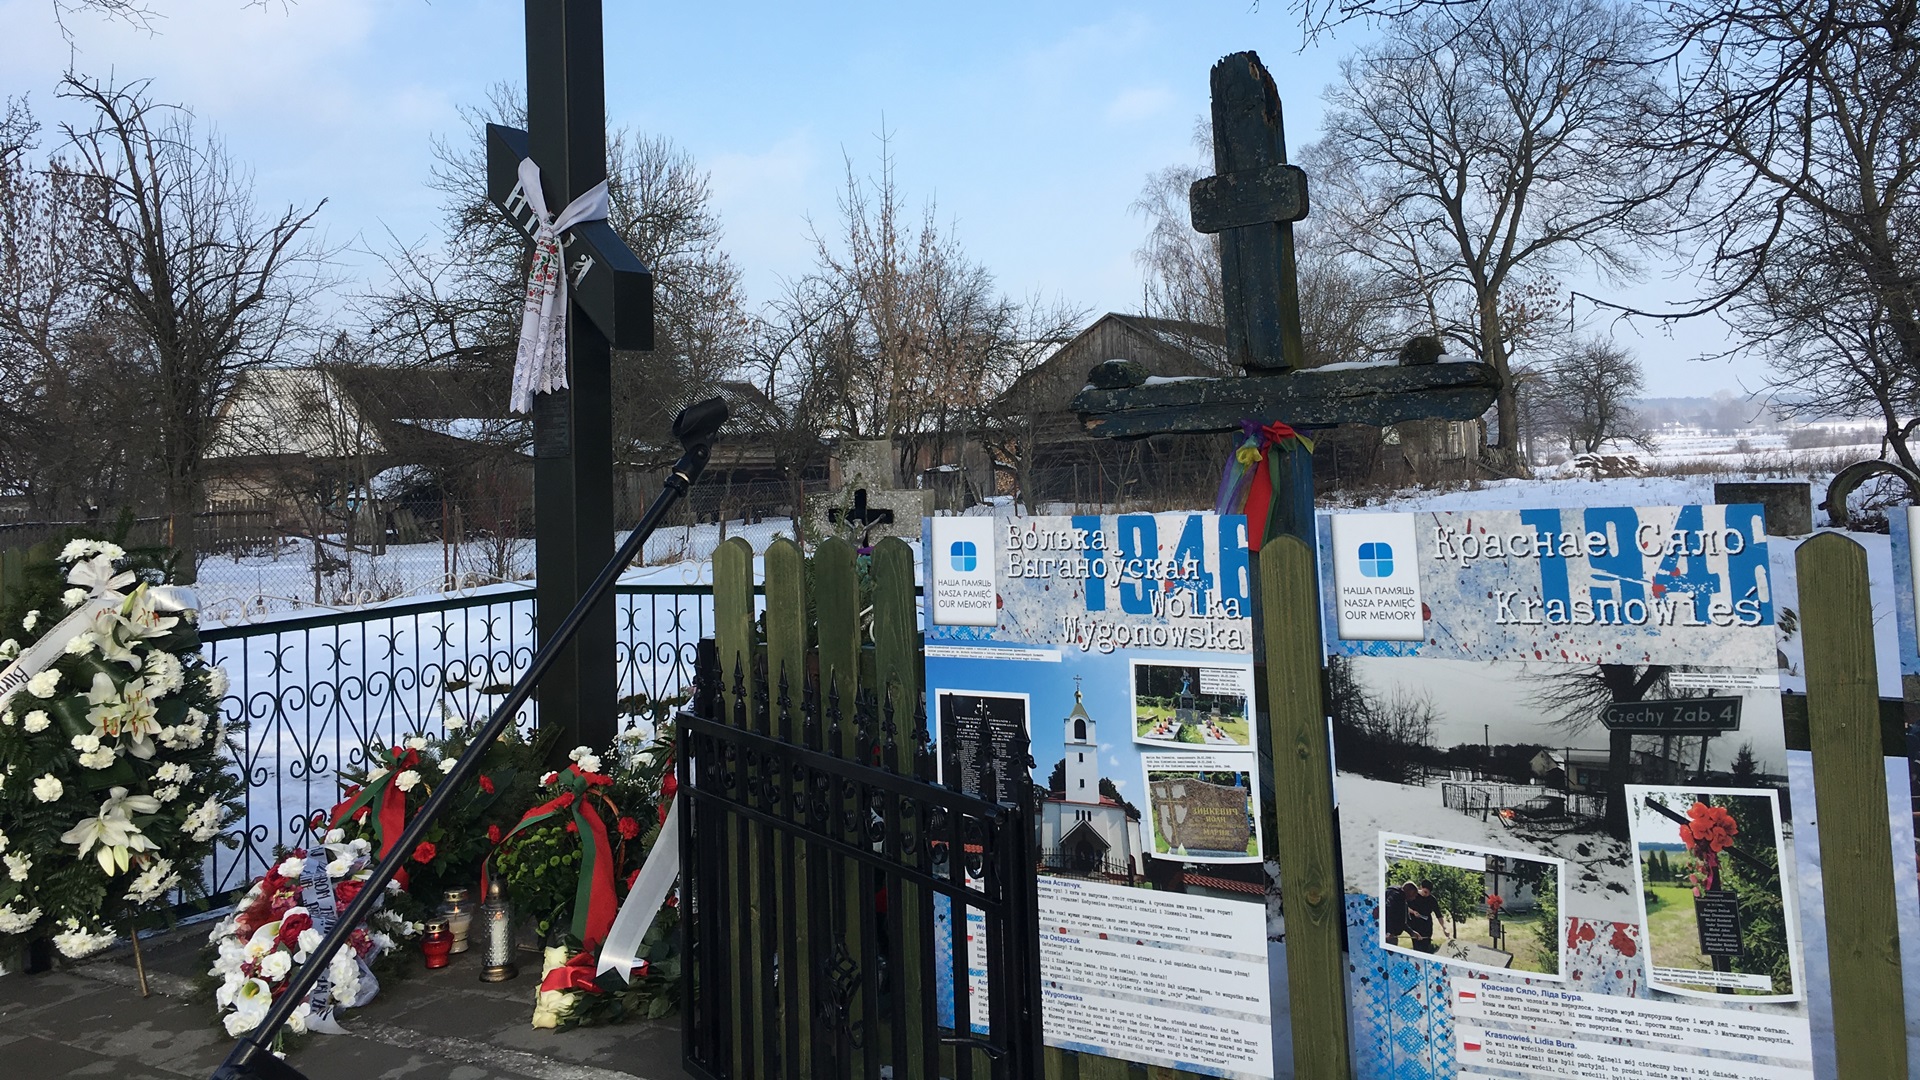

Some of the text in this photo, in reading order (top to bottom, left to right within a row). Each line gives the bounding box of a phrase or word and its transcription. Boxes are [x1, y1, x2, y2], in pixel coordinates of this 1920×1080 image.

[1006, 524, 1108, 550] Волька
[1433, 525, 1745, 568] Краснае Сяло
[1007, 551, 1200, 586] Выганоўская
[962, 579, 992, 588] ПАМЯЦЬ
[1375, 587, 1414, 596] ПАМЯЦЬ
[938, 589, 991, 599] NASZA PAMIĘĆ
[1344, 598, 1415, 608] NASZA PAMIĘĆ
[956, 600, 992, 608] MEMORY
[1149, 588, 1244, 620] Wólka
[1495, 587, 1762, 627] Krasnowieś
[1346, 611, 1416, 620] OUR MEMORY
[1062, 616, 1245, 653] Wygonowska
[1608, 706, 1734, 726] Czechy Zab. 4
[1044, 989, 1083, 1001] Wygonowska
[1481, 982, 1584, 1002] Краснае Сяло, Ліда Бура.
[1485, 1030, 1577, 1049] Krasnowieś, Lidia Bura.
